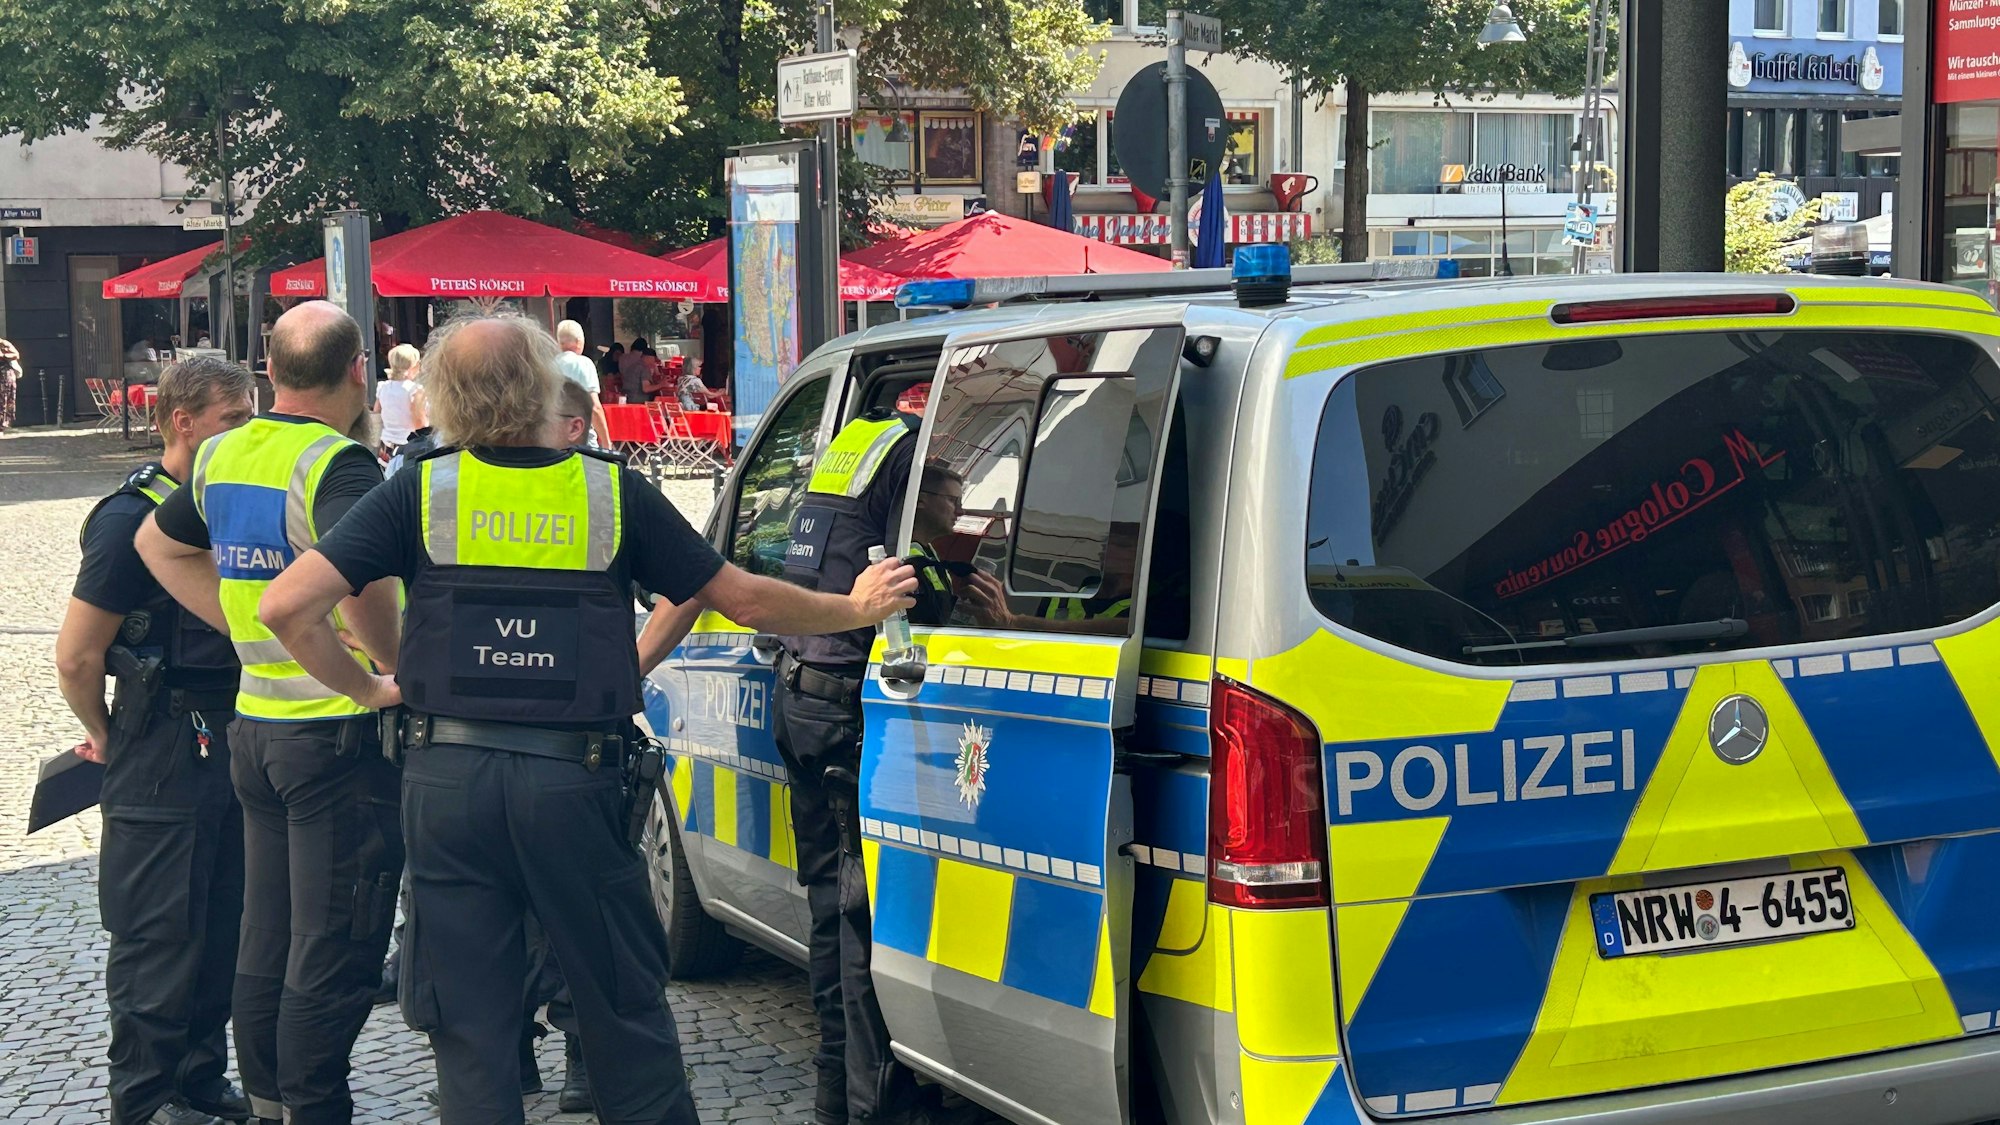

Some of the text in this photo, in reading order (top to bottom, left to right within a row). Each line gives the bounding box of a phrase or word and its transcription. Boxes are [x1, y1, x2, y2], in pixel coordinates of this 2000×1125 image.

[1184, 19, 1219, 45] Alter Markt
[1948, 52, 2000, 69] Wir tausch
[816, 89, 831, 106] Markt
[1467, 183, 1544, 193] INTERNAIONAL AG
[20, 210, 38, 218] Markt
[431, 278, 525, 291] PETERS KÖLSCH
[609, 279, 698, 293] PETERS KÖLSCH
[471, 509, 575, 546] POLIZEI
[800, 518, 815, 534] VU
[788, 540, 814, 558] Team
[495, 617, 537, 638] VU
[473, 646, 555, 668] Team
[705, 674, 767, 730] POLIZEI
[1335, 729, 1636, 816] POLIZEI
[1617, 873, 1849, 946] NRW 4-6455
[1603, 932, 1615, 946] D
